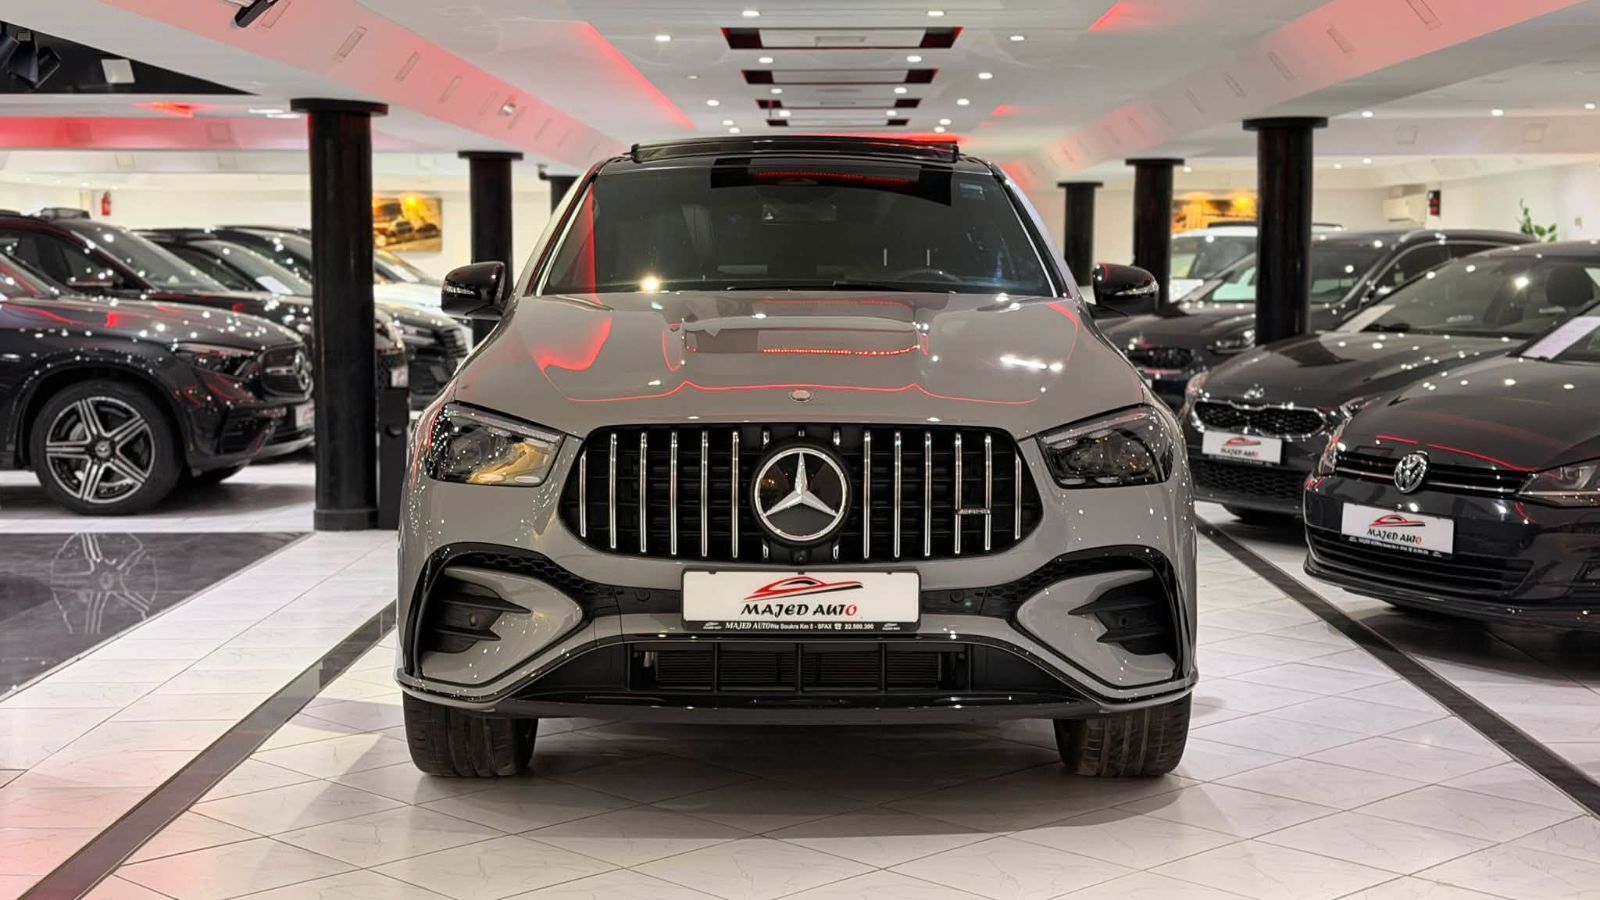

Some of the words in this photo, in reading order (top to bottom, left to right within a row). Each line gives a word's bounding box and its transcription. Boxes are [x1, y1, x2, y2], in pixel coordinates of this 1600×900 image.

[1367, 528, 1399, 540] MAJED
[1400, 533, 1422, 544] AUTO
[741, 603, 809, 618] MAJED
[813, 603, 857, 616] AUTO
[725, 621, 752, 630] MAJED
